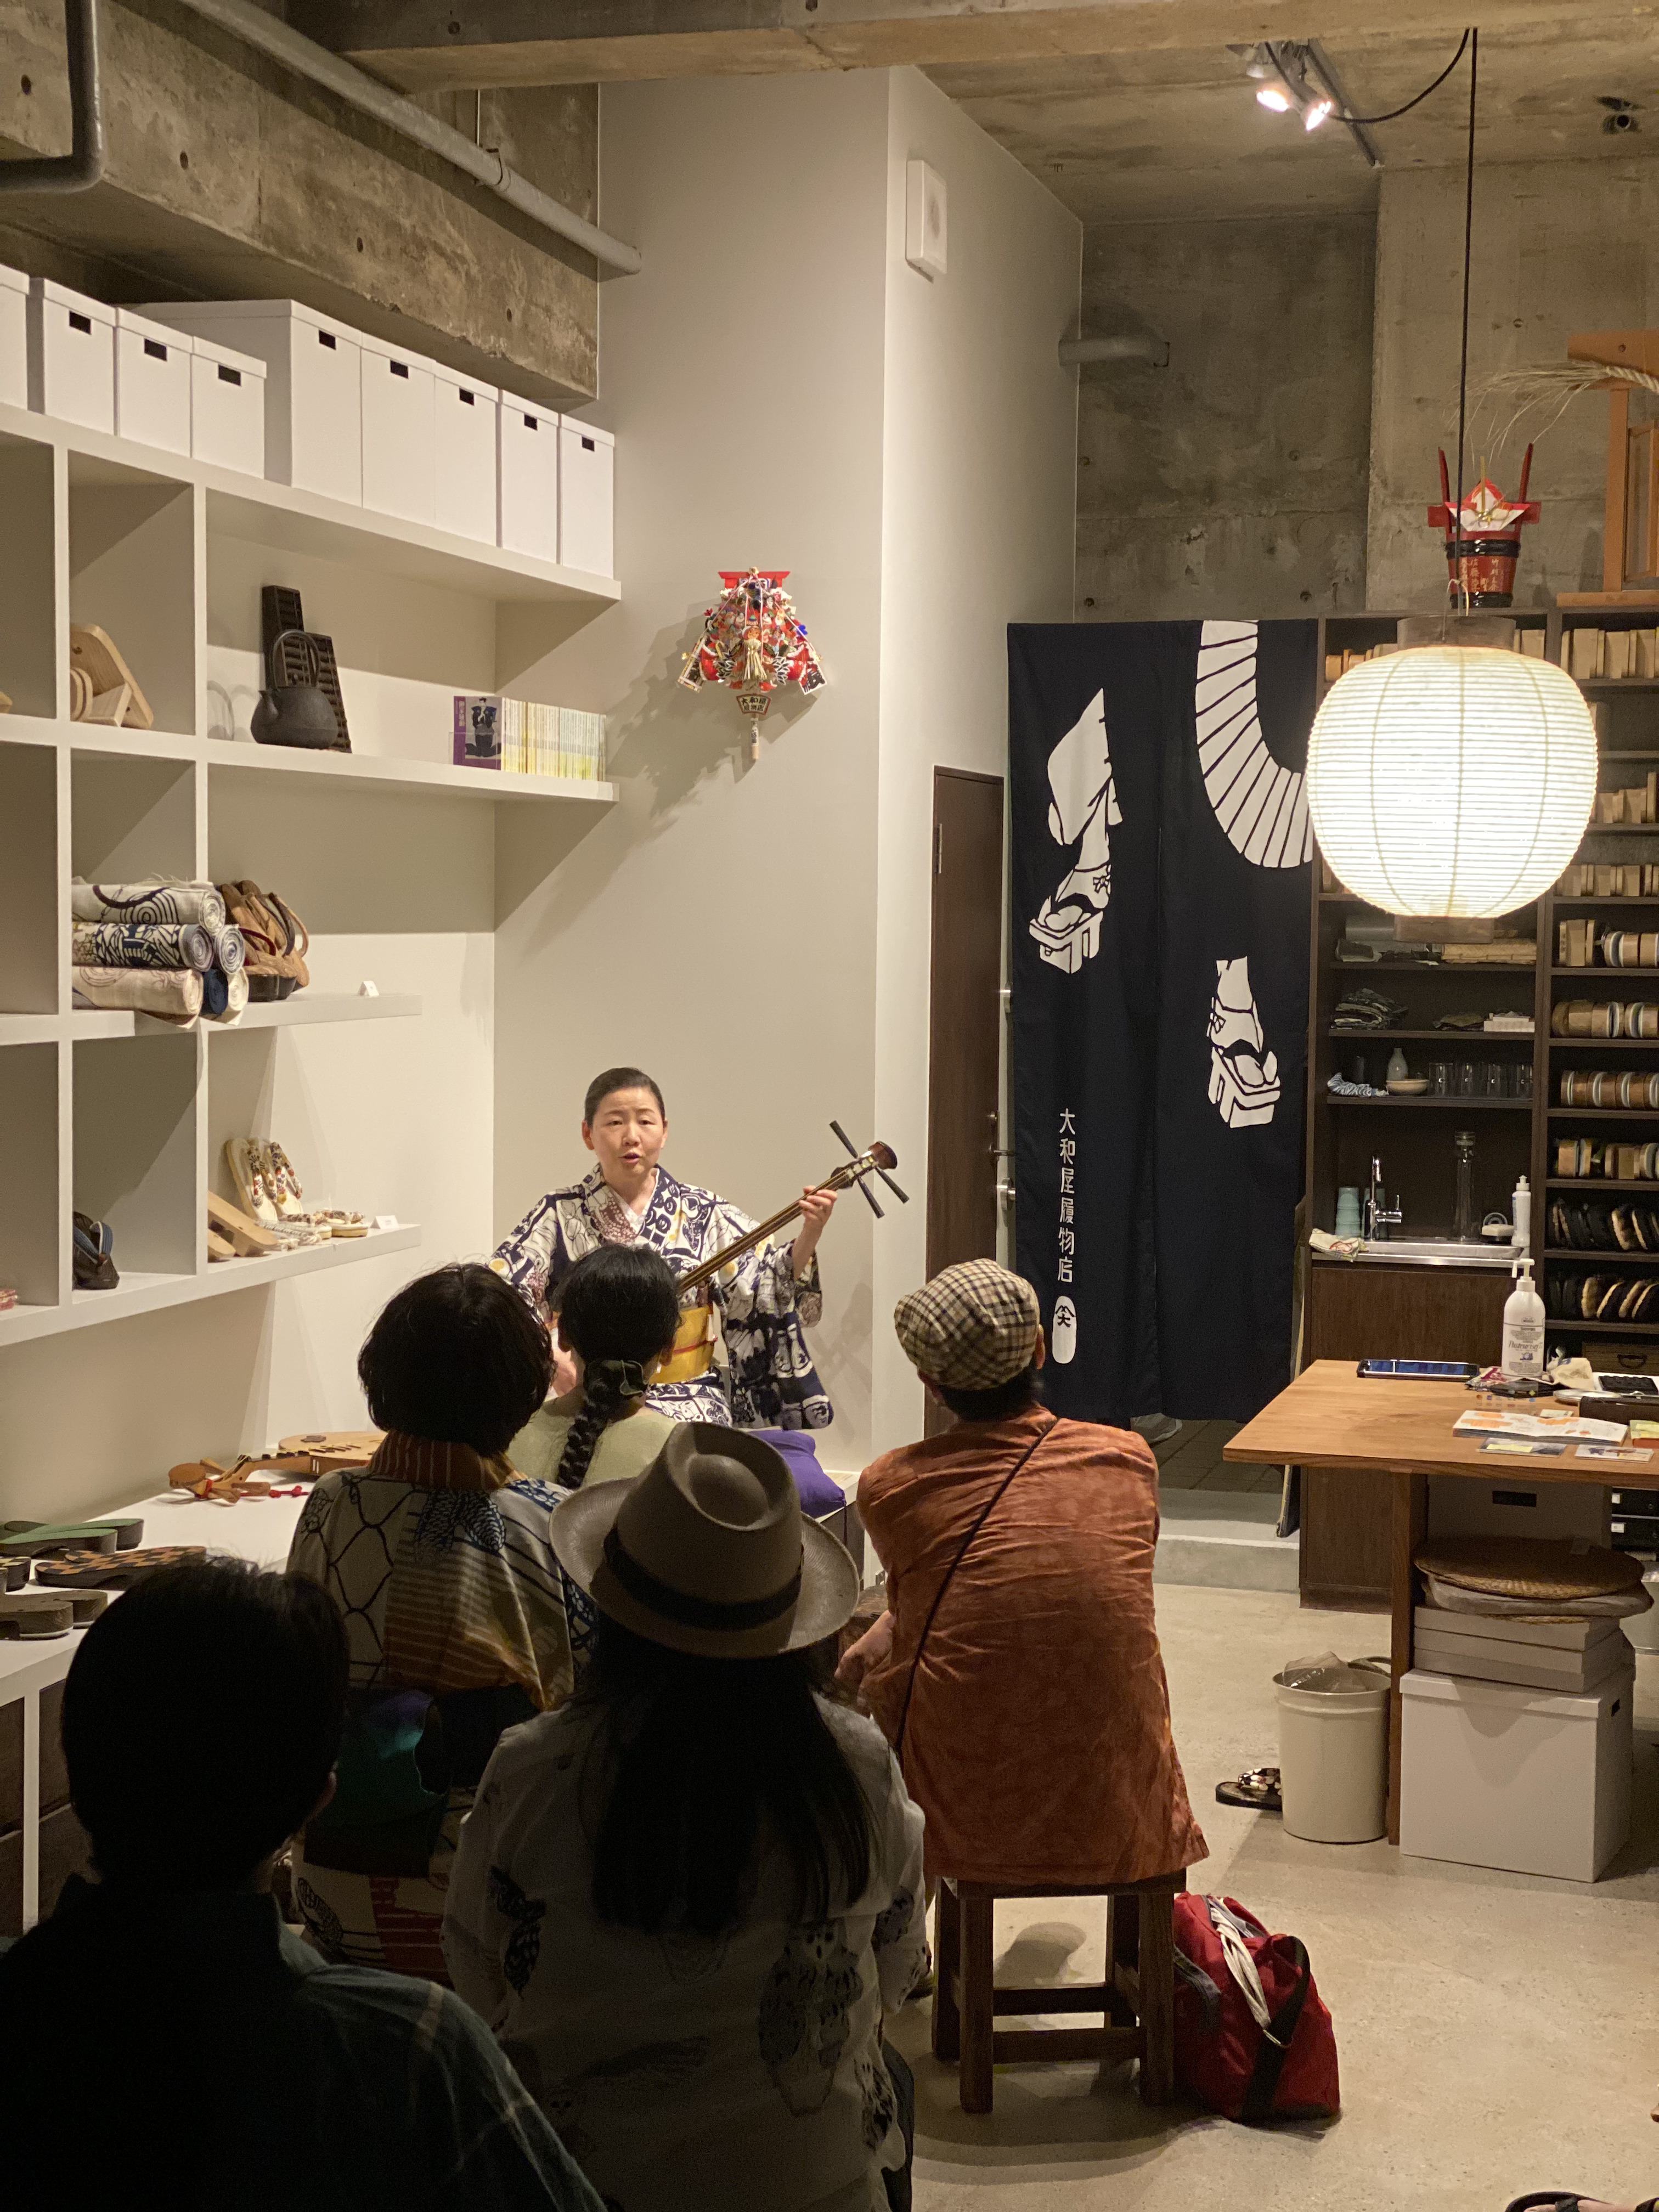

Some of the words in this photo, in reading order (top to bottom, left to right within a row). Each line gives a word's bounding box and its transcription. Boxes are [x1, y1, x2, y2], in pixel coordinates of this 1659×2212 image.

[1057, 1108, 1076, 1283] 大和屋履物店
